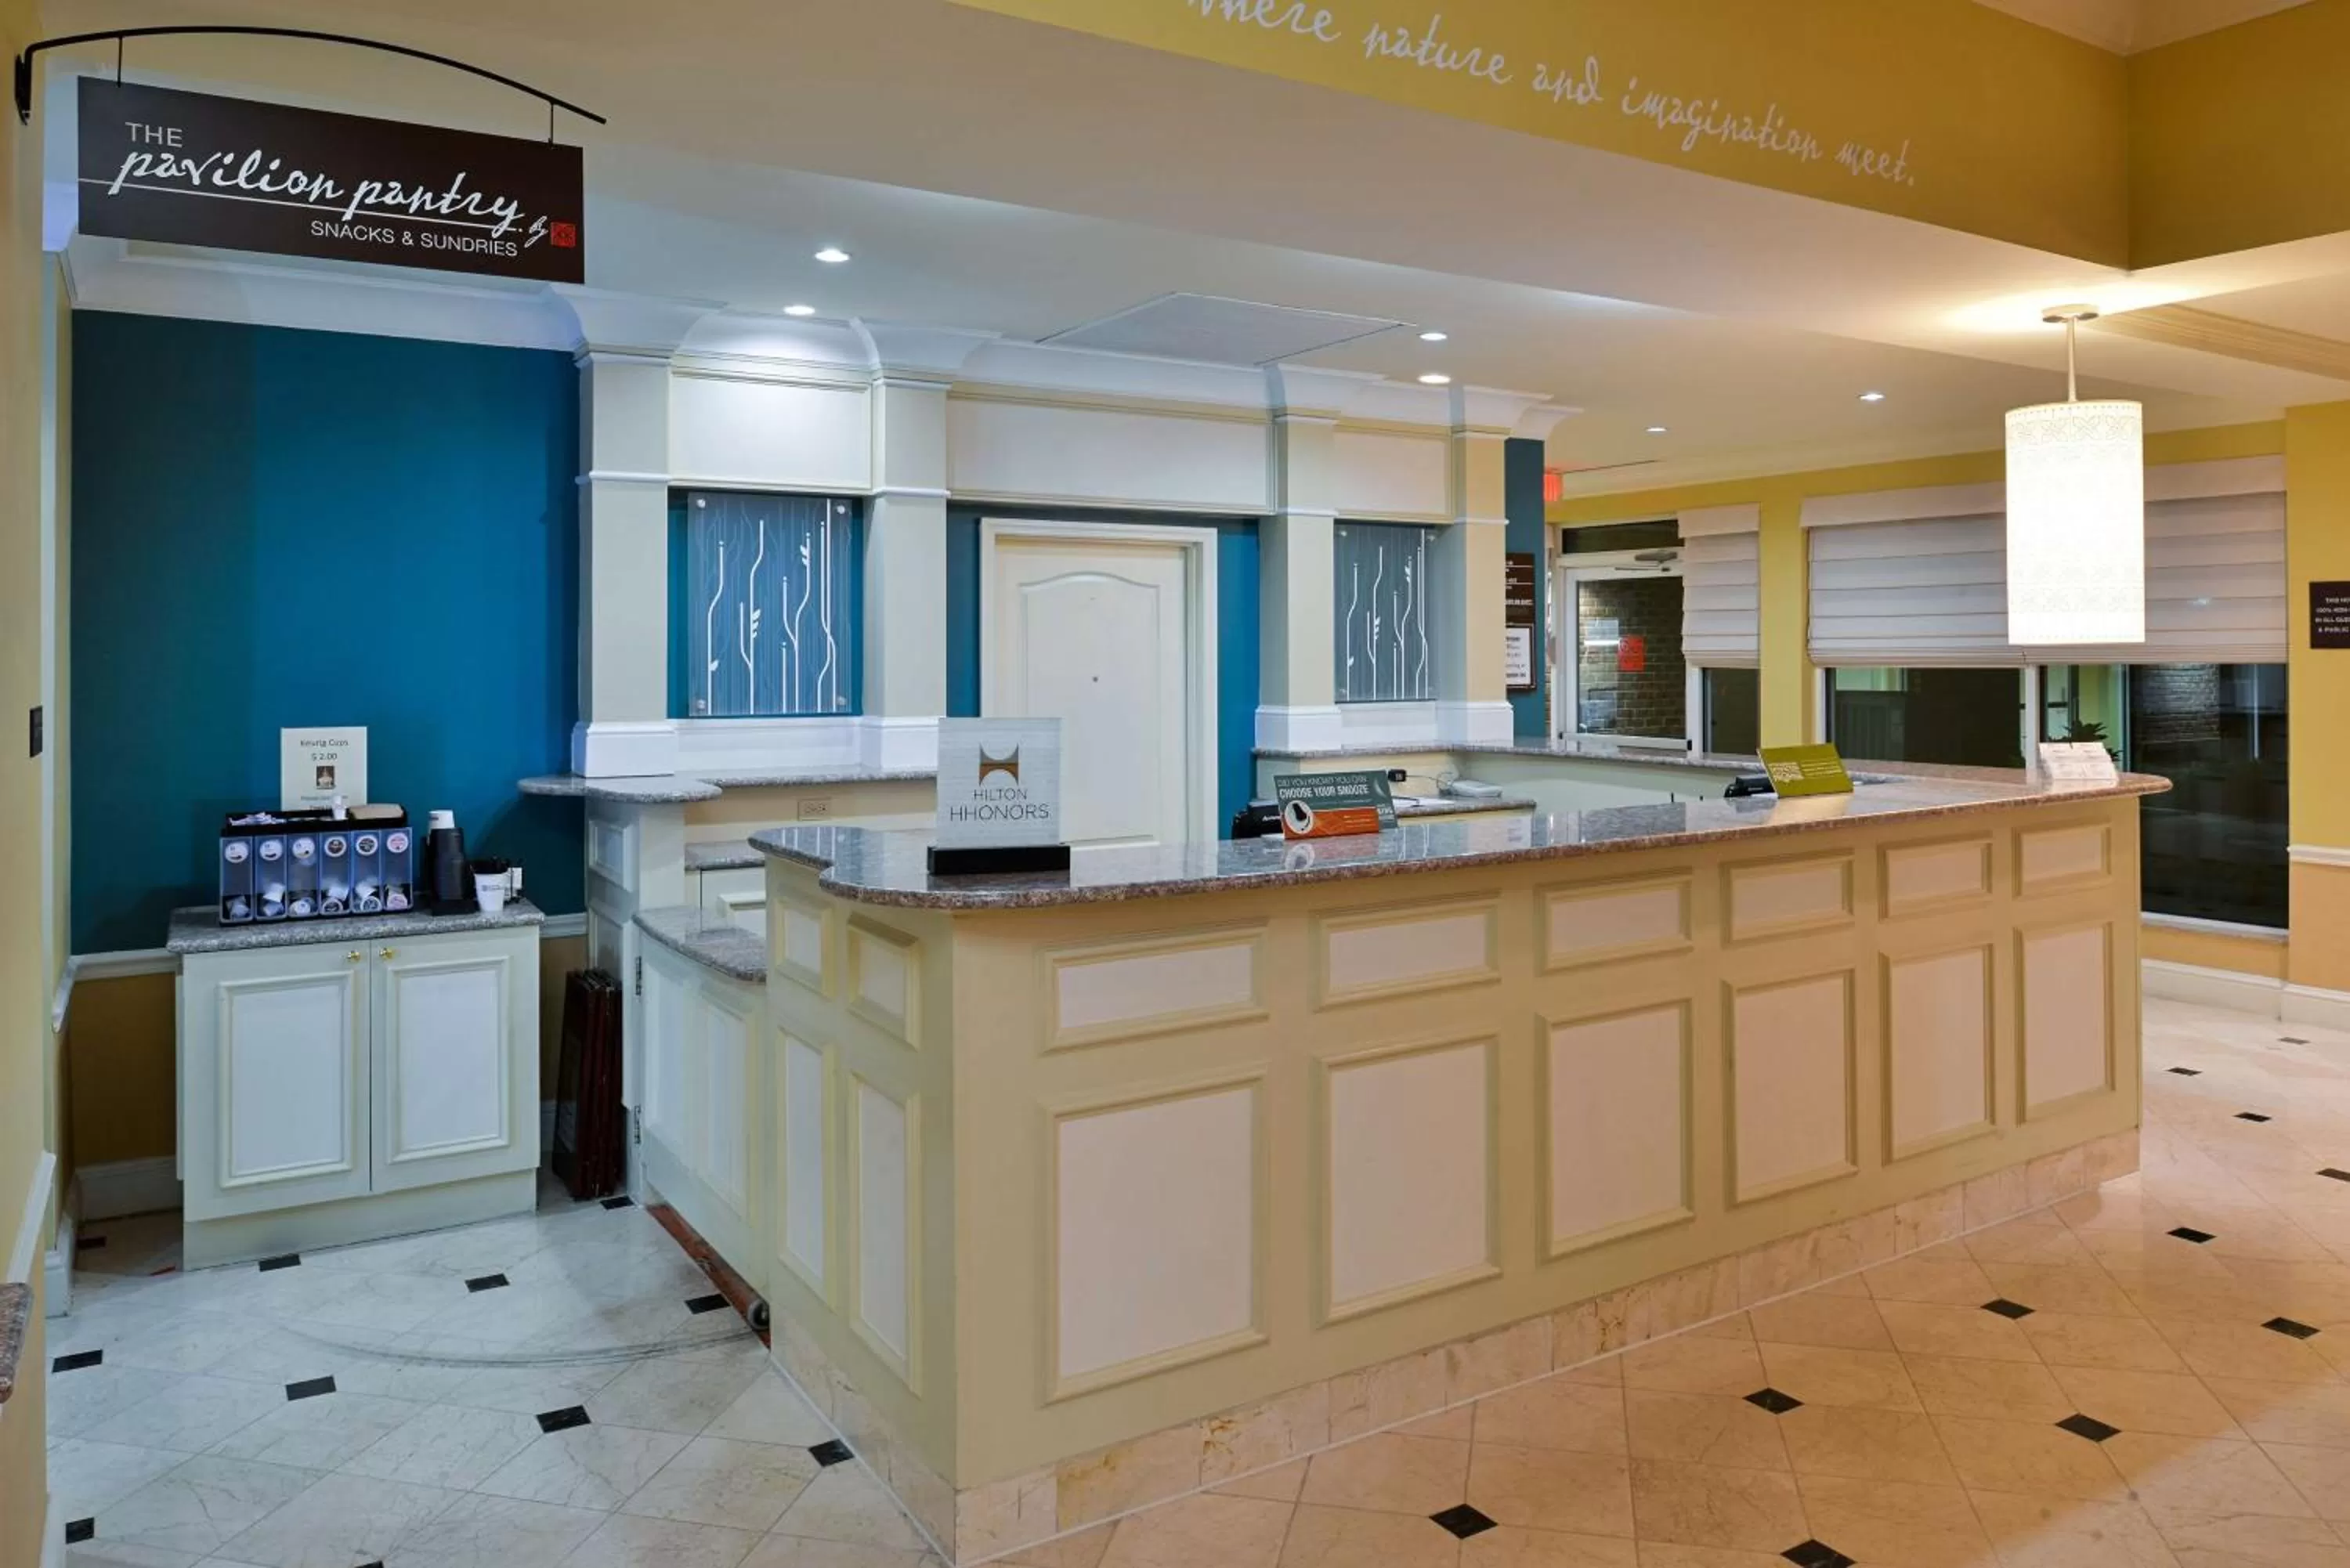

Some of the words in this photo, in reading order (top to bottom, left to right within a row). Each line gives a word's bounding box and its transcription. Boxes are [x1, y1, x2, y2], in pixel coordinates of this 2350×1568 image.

[1362, 14, 1513, 84] nature
[1531, 56, 1603, 104] and
[1622, 76, 1823, 163] imagination
[125, 121, 183, 148] THE
[107, 150, 345, 202] pavilion
[311, 219, 395, 244] SNACKS
[402, 231, 414, 246] &
[421, 233, 518, 257] SUNDRIES
[974, 788, 1029, 801] HILTON
[1279, 786, 1314, 799] CHOOSE
[1314, 786, 1336, 797] YOUR
[1337, 784, 1369, 796] SNOOZE
[950, 804, 1051, 822] HHONORS
